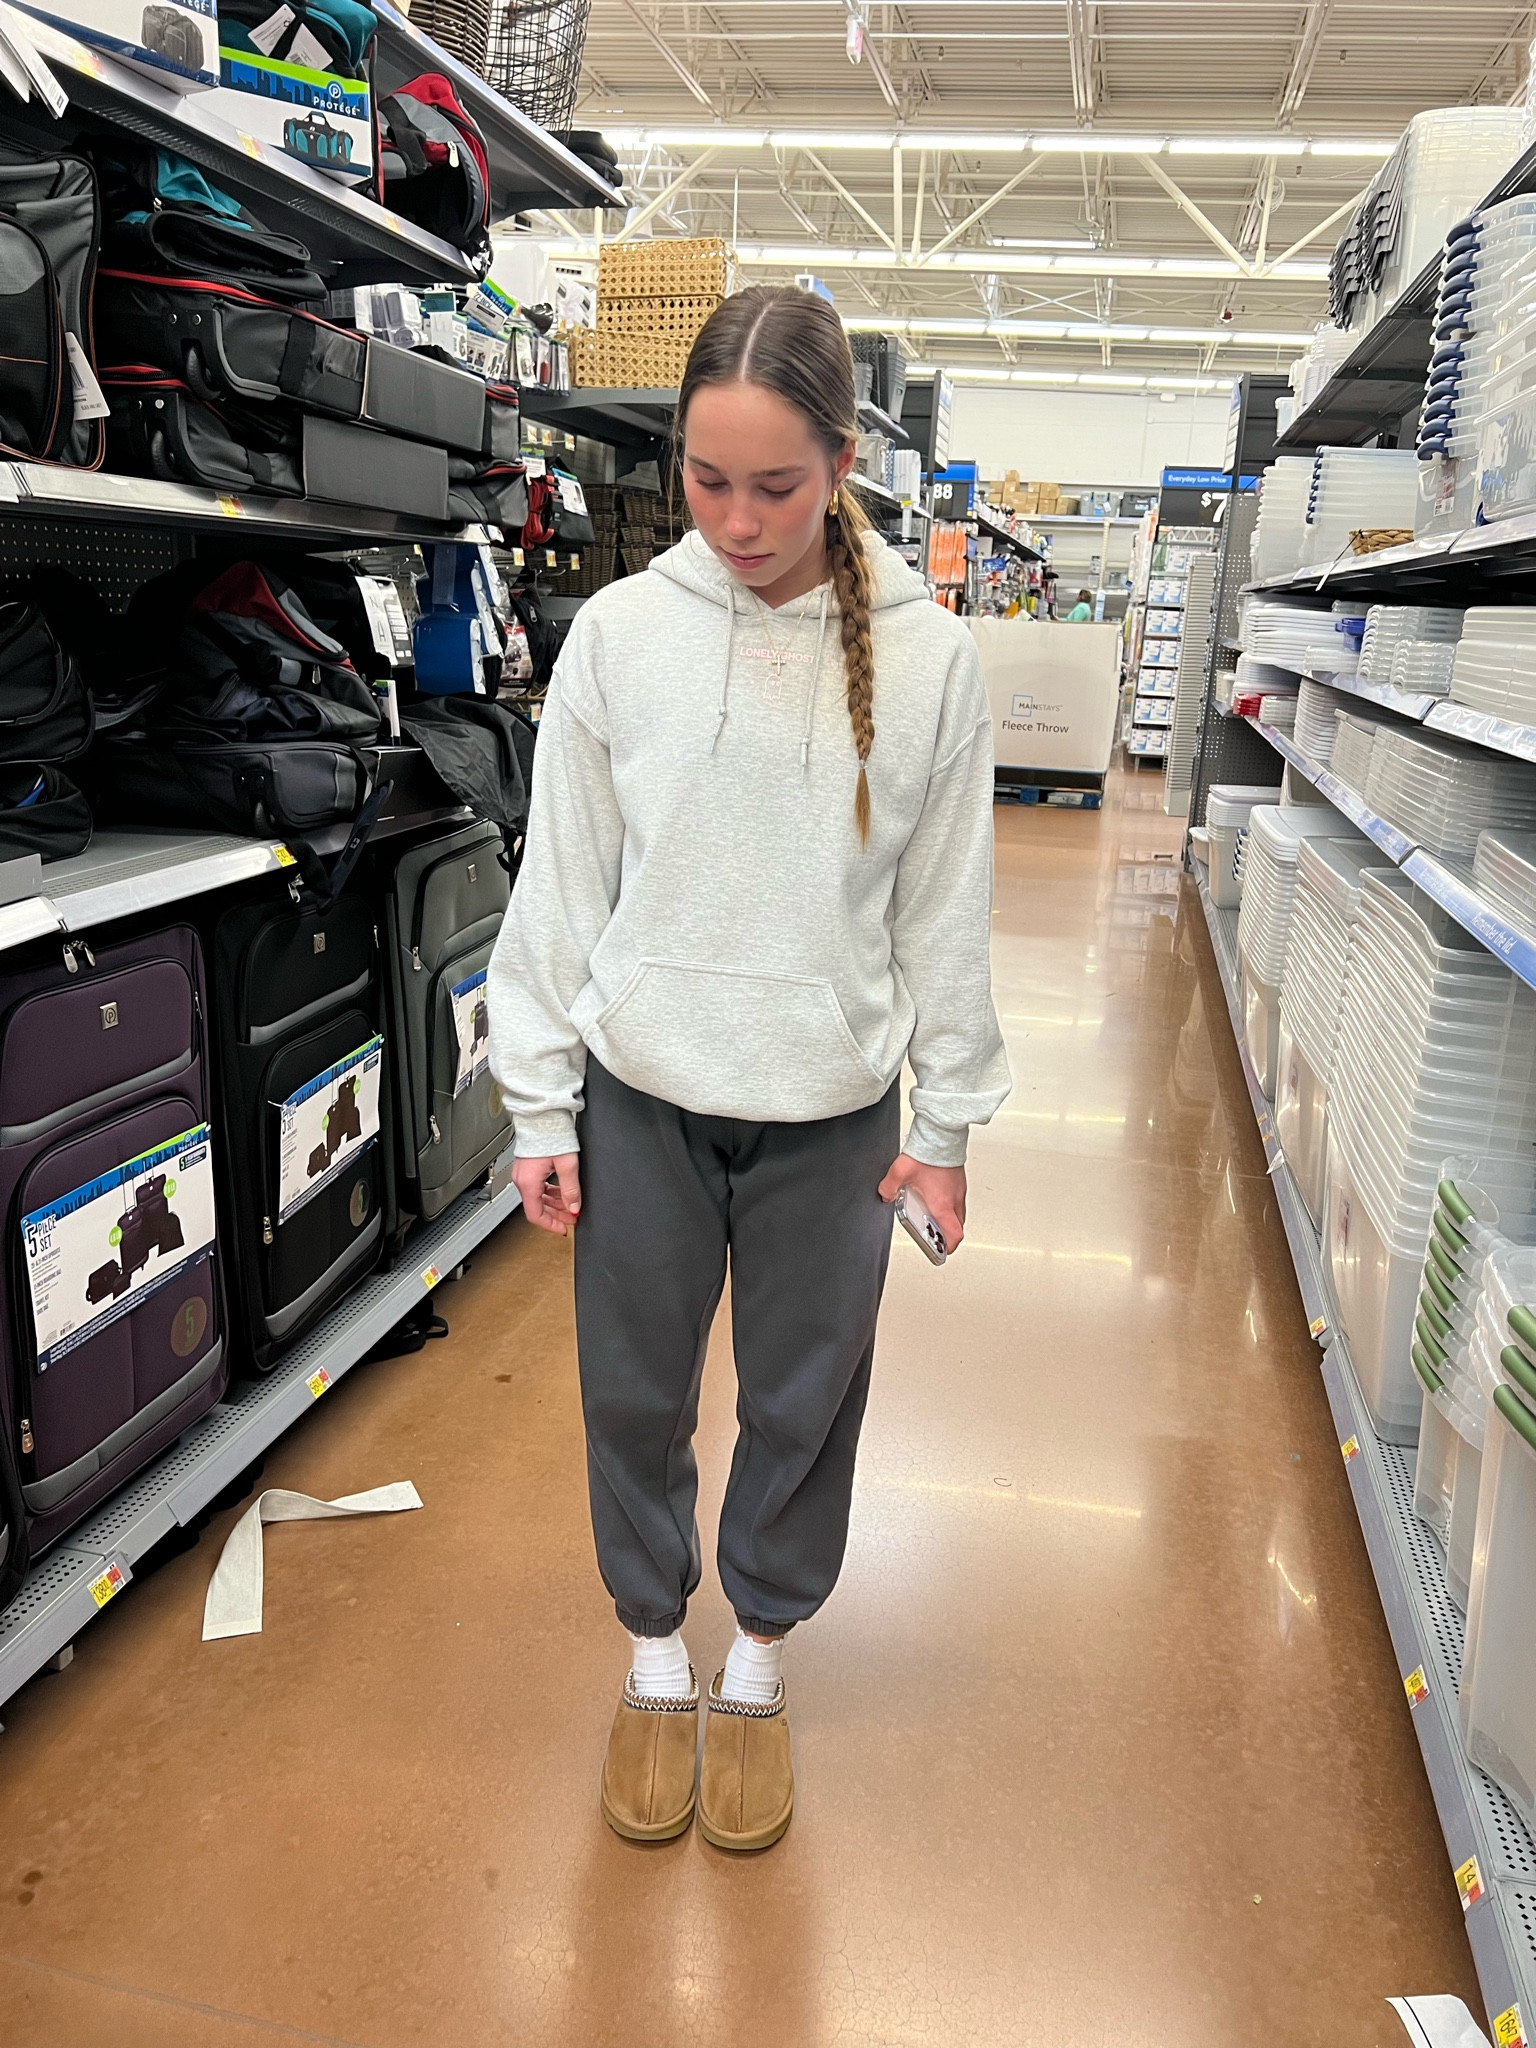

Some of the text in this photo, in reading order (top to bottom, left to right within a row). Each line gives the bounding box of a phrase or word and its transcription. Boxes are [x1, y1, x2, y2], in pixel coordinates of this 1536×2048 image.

[1168, 474, 1227, 484] Everyday Low Price
[740, 647, 815, 664] LONELY GHOST
[1019, 702, 1060, 712] MAINSTAYS
[1002, 720, 1069, 733] Fleece Throw
[1471, 911, 1499, 940] Remember
[1493, 930, 1507, 948] the
[27, 1226, 38, 1257] 5
[37, 1215, 57, 1236] PIECE
[39, 1234, 52, 1252] SET
